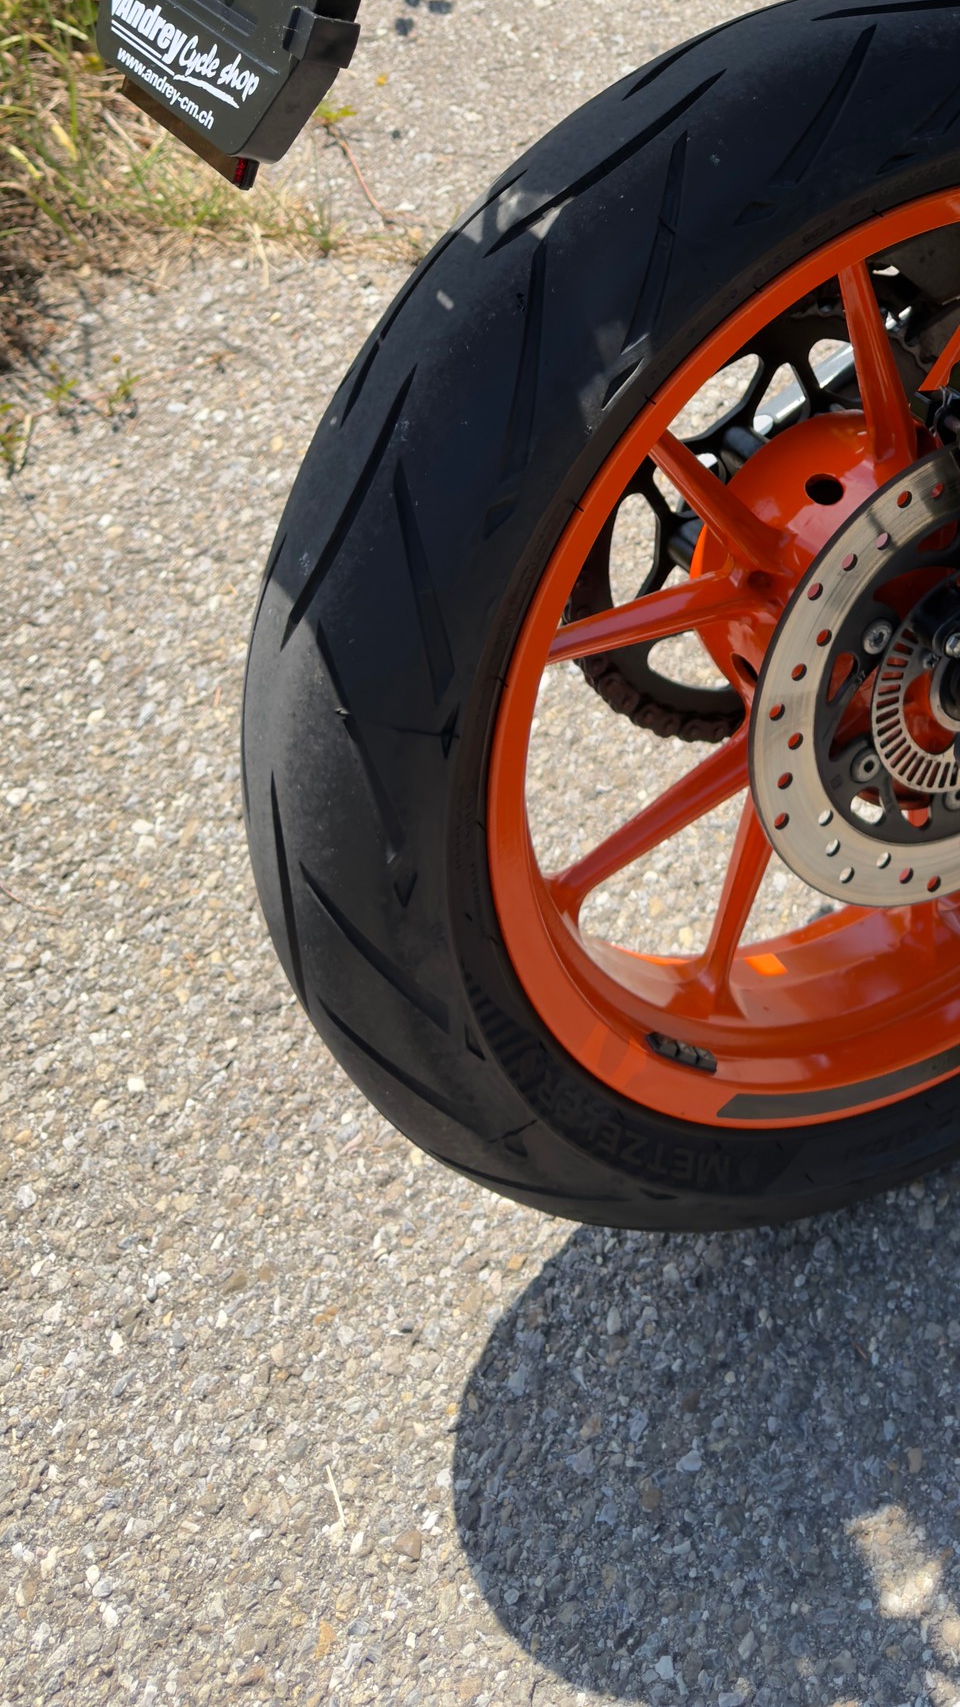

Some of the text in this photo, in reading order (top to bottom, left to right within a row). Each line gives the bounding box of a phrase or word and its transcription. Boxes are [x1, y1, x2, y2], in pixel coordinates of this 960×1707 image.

[117, 48, 215, 130] www.andrey-cm.ch
[180, 35, 219, 78] Cycle
[219, 54, 260, 102] shop
